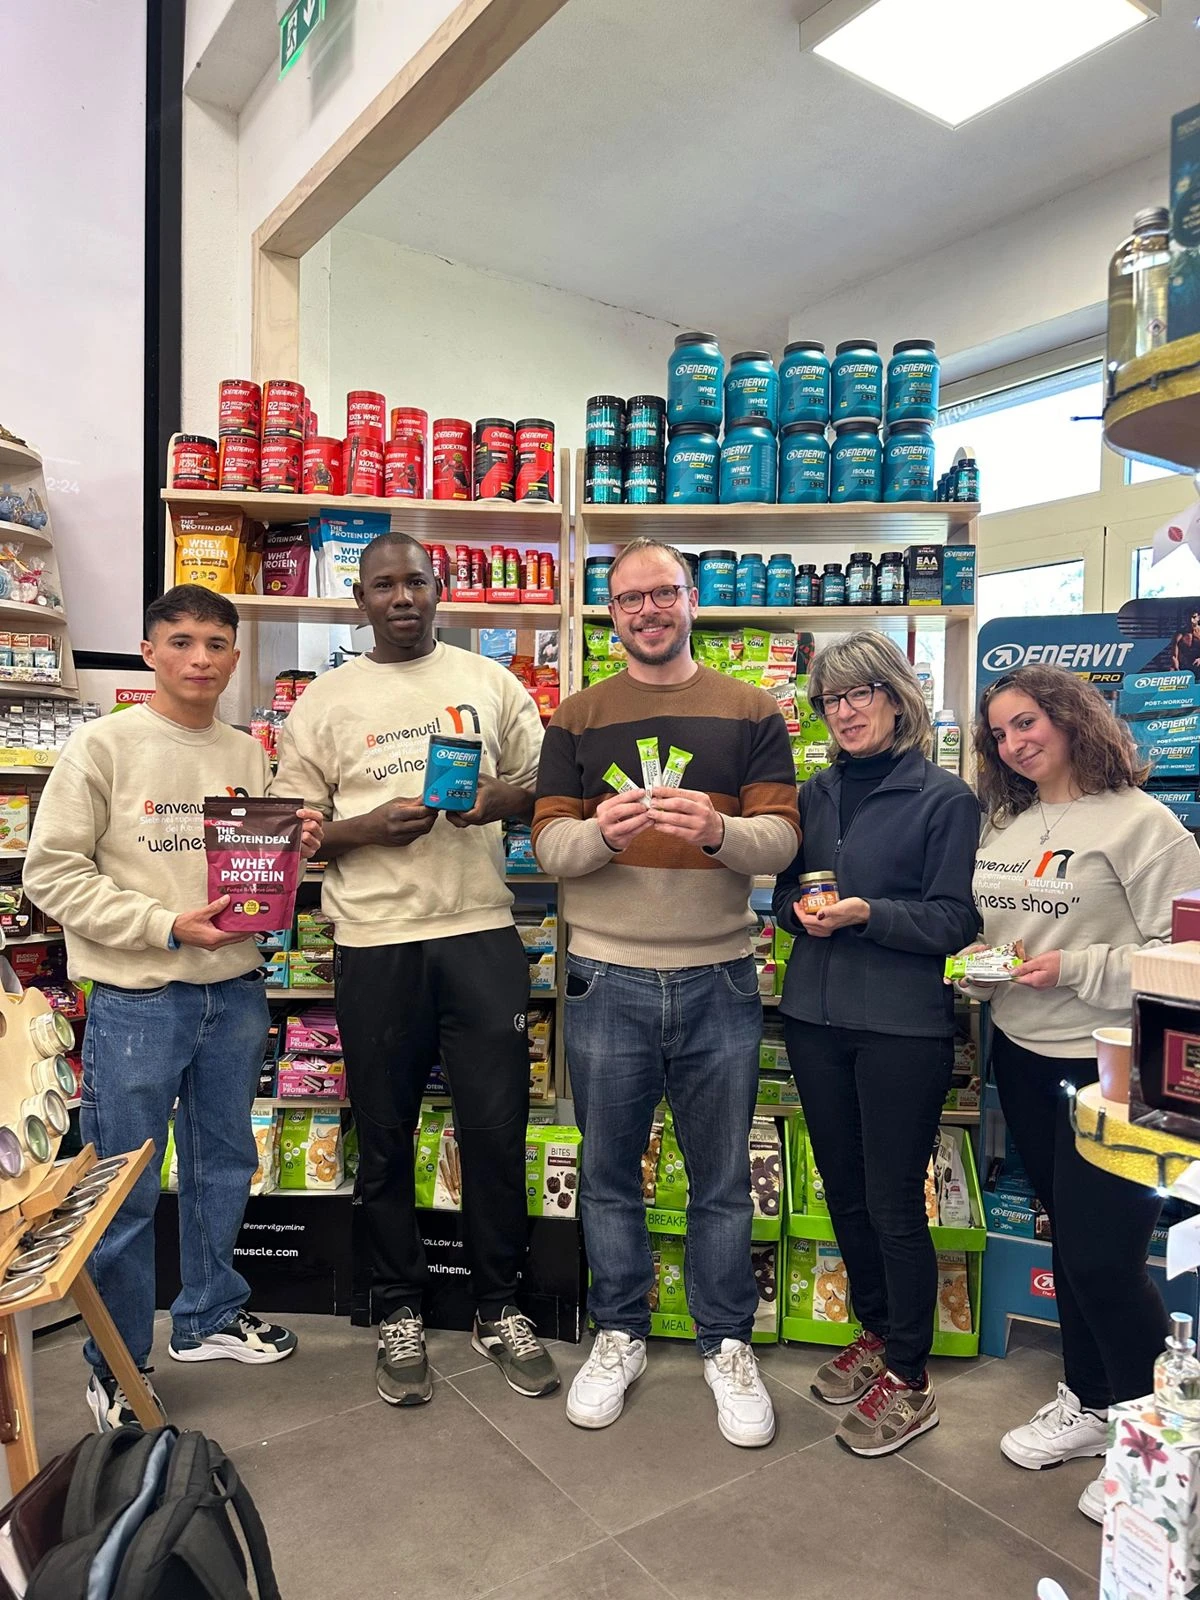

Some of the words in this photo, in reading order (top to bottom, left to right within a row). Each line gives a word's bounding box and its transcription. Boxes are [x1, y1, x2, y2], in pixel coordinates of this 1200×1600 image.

[686, 364, 718, 375] ENERVIT
[796, 365, 826, 375] ENERVIT
[848, 364, 878, 373] ENERVIT
[903, 363, 934, 372] ENERVIT
[736, 378, 768, 388] ENERVIT
[698, 386, 716, 394] WHEY
[221, 402, 230, 410] R2
[268, 402, 278, 410] R2
[750, 398, 768, 406] WHEY
[363, 414, 381, 422] WHEY
[797, 450, 827, 459] ENERVIT
[847, 448, 876, 458] ENERVIT
[901, 446, 932, 456] ENERVIT
[225, 458, 235, 466] R2
[683, 455, 715, 464] ENERVIT
[731, 466, 750, 474] WHEY
[695, 474, 713, 482] WHEY
[330, 524, 342, 532] THE
[330, 531, 363, 539] PROTEIN
[189, 539, 221, 549] WHEY
[182, 548, 228, 558] PROTEIN
[268, 551, 291, 560] WHEY
[263, 559, 297, 569] PROTEIN
[773, 638, 794, 646] CHIPS
[1022, 643, 1135, 667] ENERVIT
[1091, 674, 1121, 682] PRO
[1150, 676, 1192, 686] ENERVIT
[1145, 698, 1193, 706] POST-WORKOUT
[1161, 716, 1198, 729] ENERVIT
[366, 717, 441, 748] Benvenuti!
[1160, 746, 1195, 755] ENERVIT
[448, 750, 477, 762] ENERVIT
[366, 758, 428, 780] "welne
[216, 827, 235, 835] THE
[218, 835, 263, 844] PROTEIN
[264, 835, 290, 844] DEAL
[231, 858, 275, 869] WHEY
[221, 870, 284, 882] PROTEIN
[808, 896, 826, 907] KETO
[551, 1148, 570, 1156] BITES
[1002, 1209, 1032, 1220] ENERVIT
[451, 1240, 463, 1248] US
[794, 1245, 809, 1253] ZONA
[662, 1320, 688, 1331] MEAL
